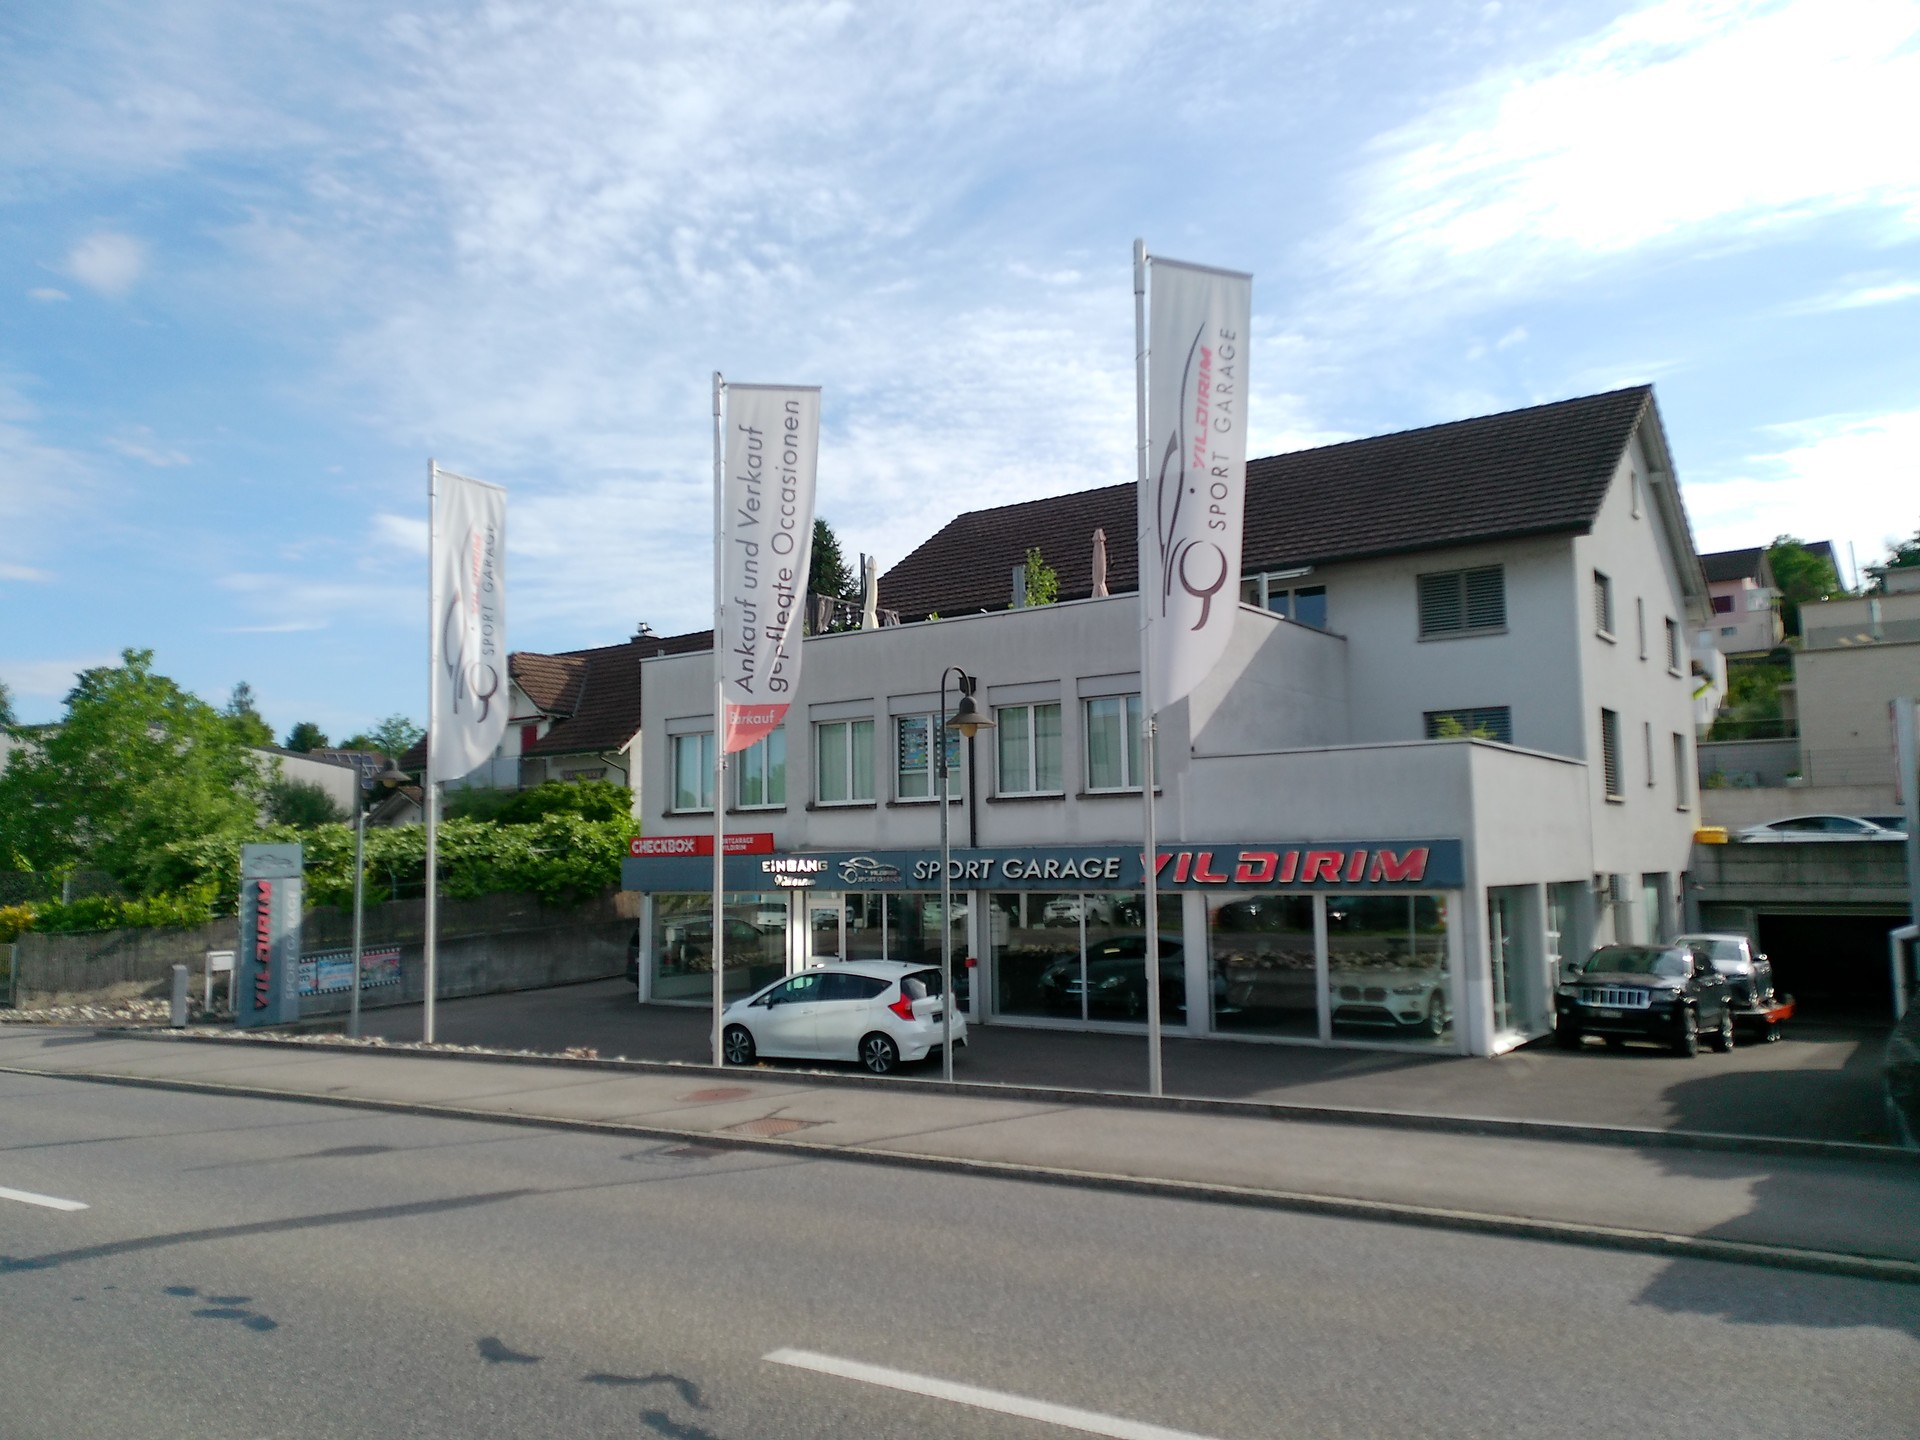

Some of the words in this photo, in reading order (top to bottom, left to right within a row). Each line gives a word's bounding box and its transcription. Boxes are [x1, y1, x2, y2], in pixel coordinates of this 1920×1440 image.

[1193, 346, 1212, 469] YILDIRIM
[1213, 327, 1237, 432] GARAGE
[737, 424, 763, 527] Verkauf
[771, 400, 800, 556] Occasionen
[1208, 451, 1229, 531] SPORT
[735, 539, 759, 589] und
[483, 607, 495, 656] SPORT
[734, 597, 757, 694] Ankauf
[766, 568, 796, 693] gepflegte
[631, 839, 695, 854] CHECKBOX
[912, 859, 995, 881] SPORT
[1002, 857, 1121, 880] GARAGE
[1139, 848, 1430, 884] YILDIRIM
[255, 880, 272, 1009] YILDIRIM
